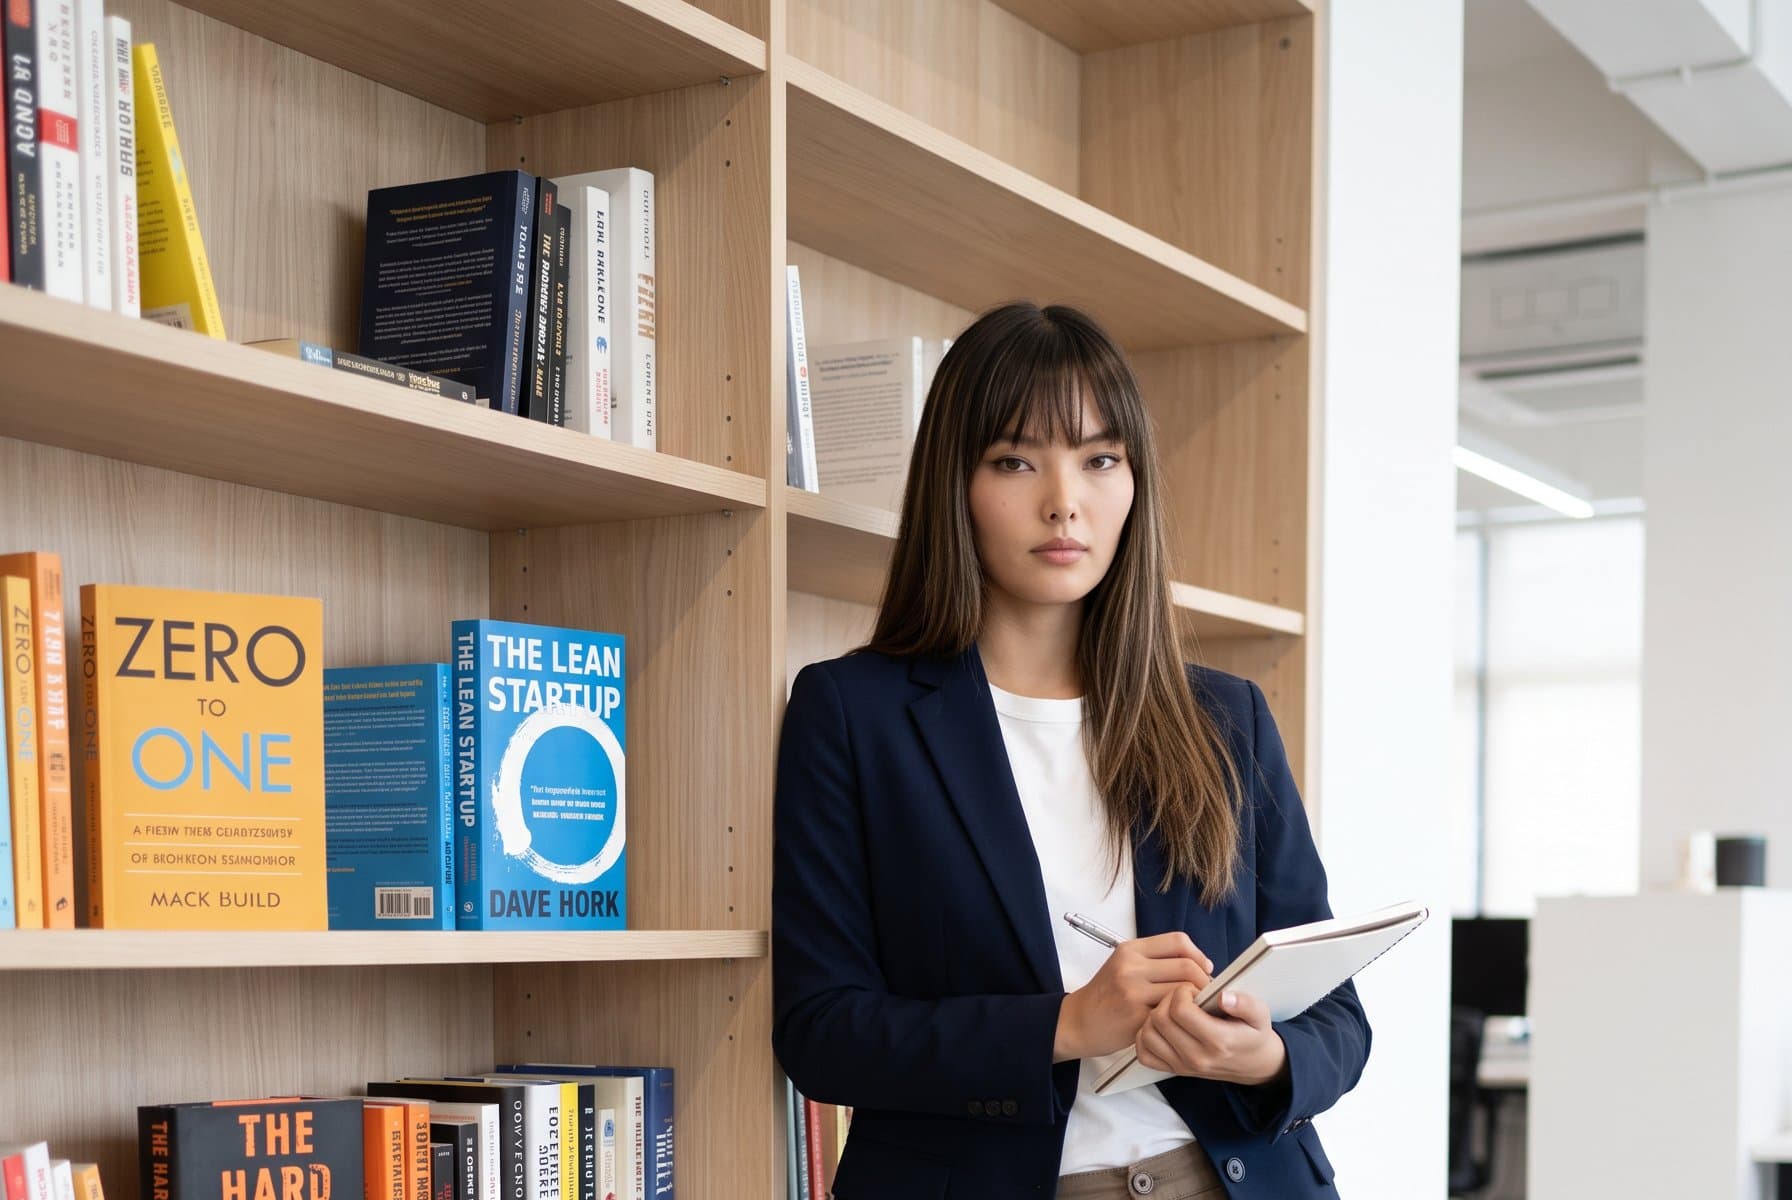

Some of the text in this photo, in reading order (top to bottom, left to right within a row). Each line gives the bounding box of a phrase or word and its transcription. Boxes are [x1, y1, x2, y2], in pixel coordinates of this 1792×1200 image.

[13, 604, 32, 676] ZERO
[79, 614, 96, 680] ZERO
[115, 616, 306, 687] ZERO
[487, 634, 621, 678] THE LEAN
[197, 698, 226, 717] TO
[488, 676, 621, 719] STARTUP
[458, 632, 476, 827] THE LEAN STARTUP
[131, 727, 292, 793] ONE
[133, 825, 141, 836] A
[150, 891, 281, 908] MACK BUILD
[490, 889, 619, 918] DAVE HORK
[151, 1121, 168, 1163] THE
[238, 1111, 313, 1157] THE
